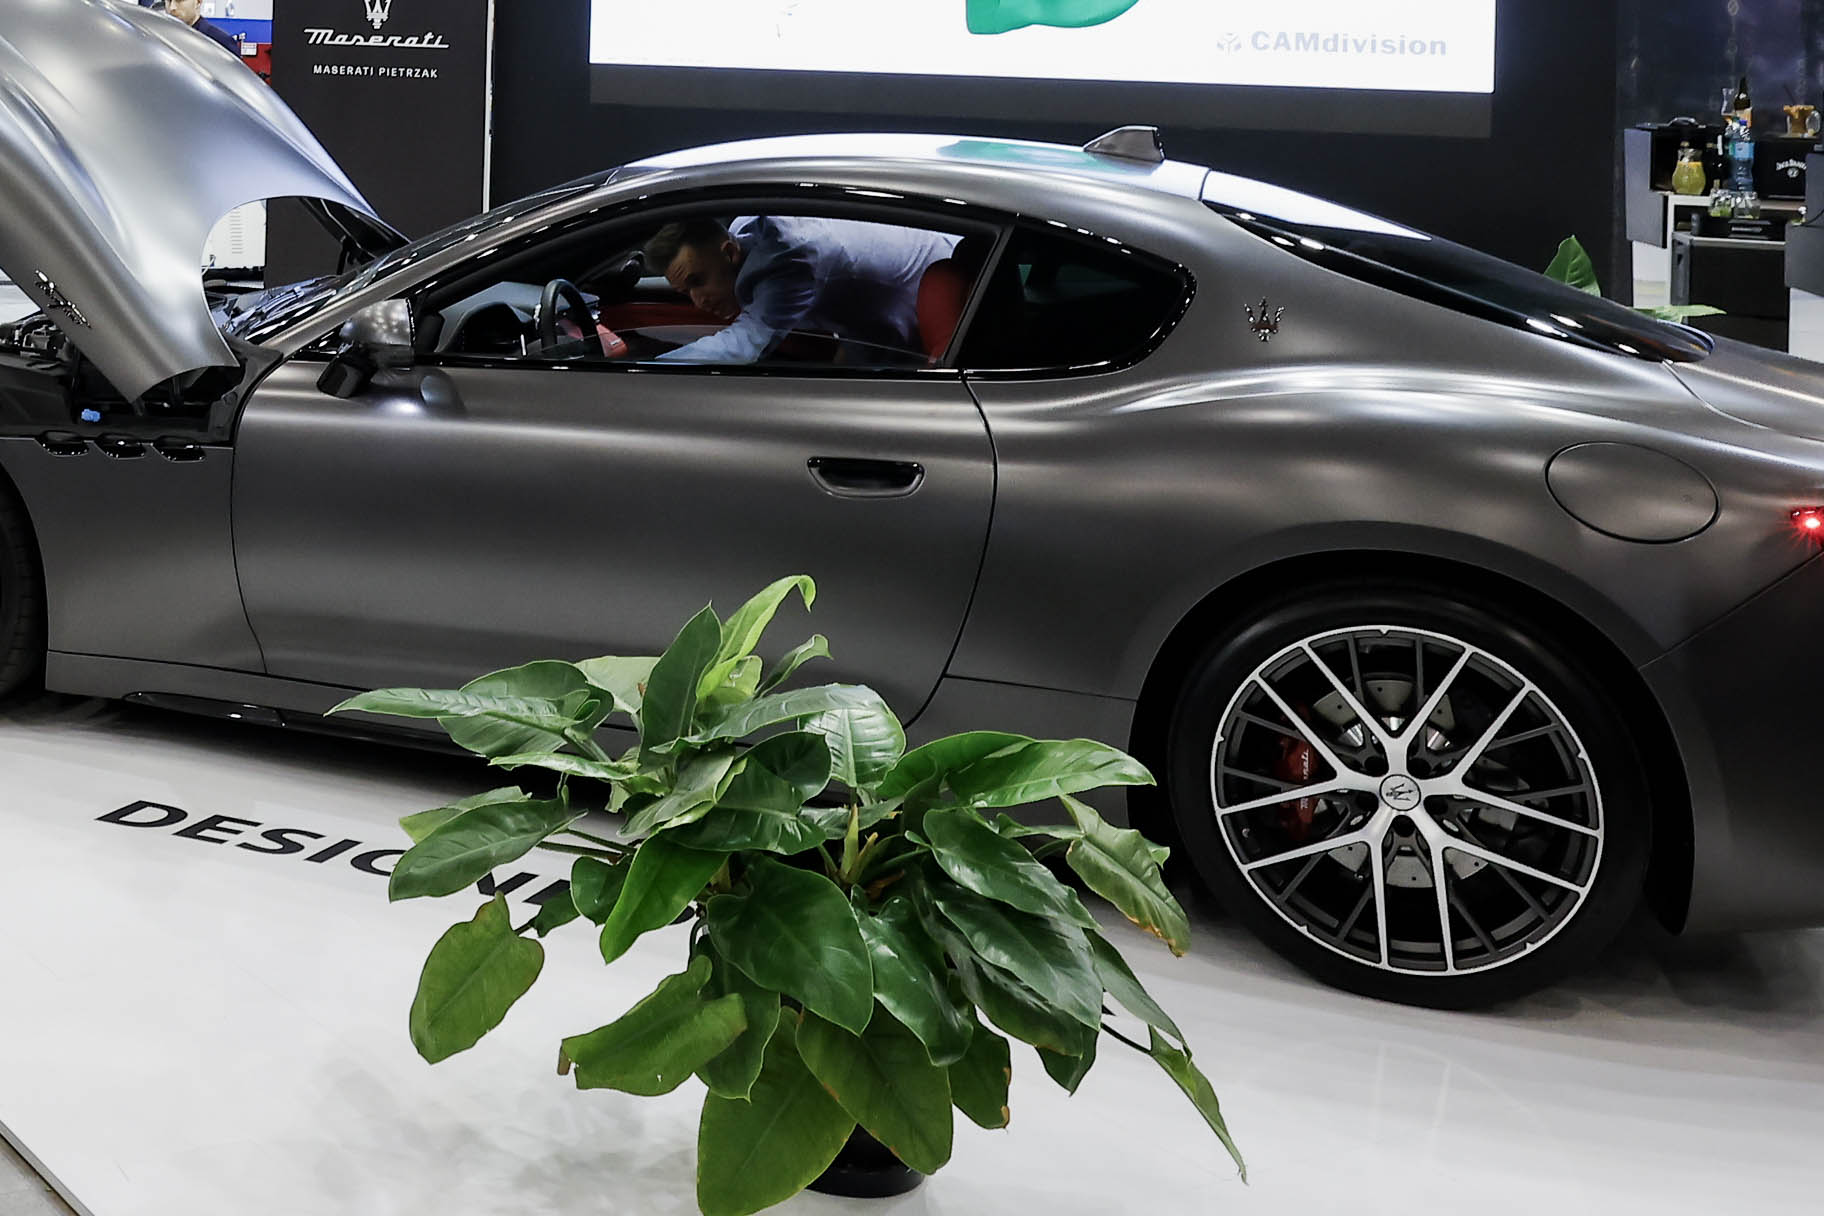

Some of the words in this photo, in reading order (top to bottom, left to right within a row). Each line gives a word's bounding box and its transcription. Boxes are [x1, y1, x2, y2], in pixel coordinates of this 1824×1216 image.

[304, 28, 450, 49] Maserati
[1251, 30, 1447, 56] CAMdivision
[313, 64, 374, 77] MASERATI
[378, 66, 438, 79] PIETRZAK
